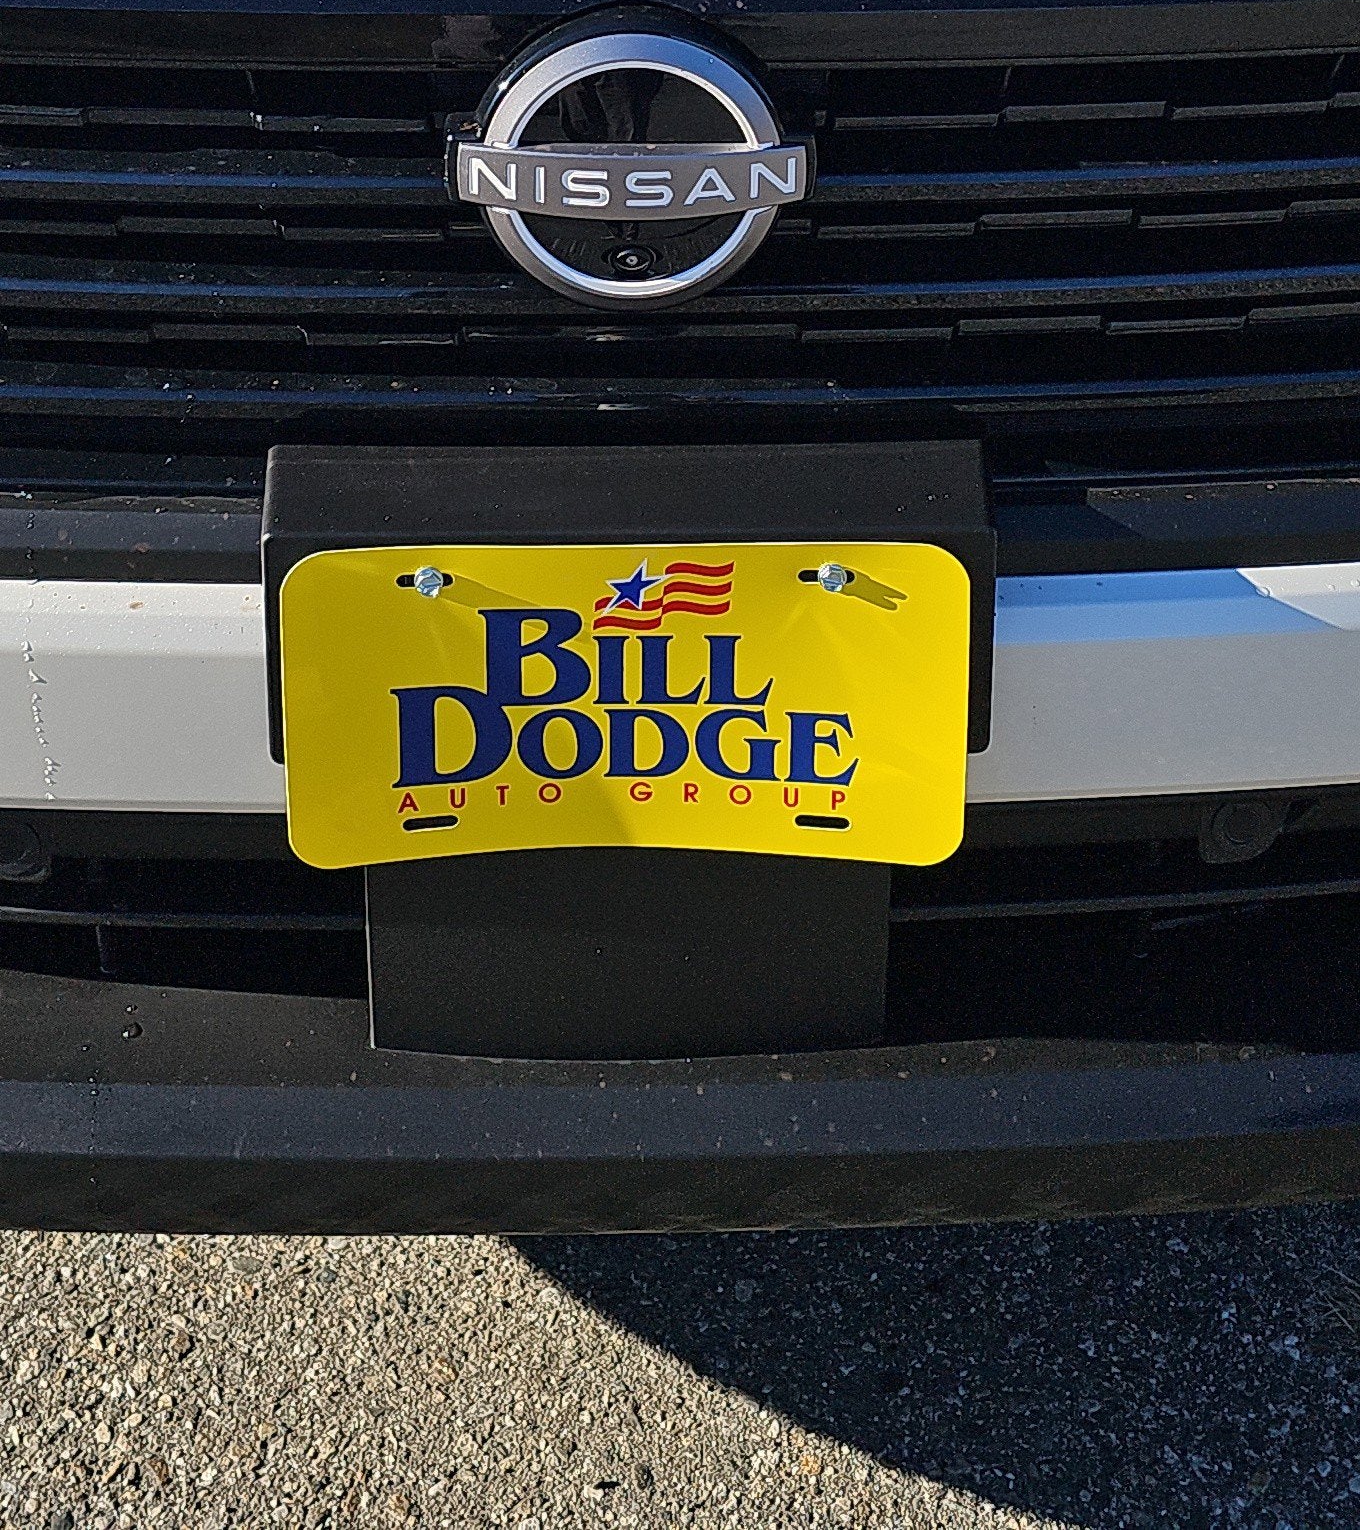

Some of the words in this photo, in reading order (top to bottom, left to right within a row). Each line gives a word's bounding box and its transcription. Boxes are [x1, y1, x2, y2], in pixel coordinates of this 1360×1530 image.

[468, 156, 798, 208] NISSAN
[478, 608, 774, 707] BILL
[390, 685, 860, 788] DODGE
[397, 782, 564, 816] AUTO
[628, 781, 848, 811] GROUP
